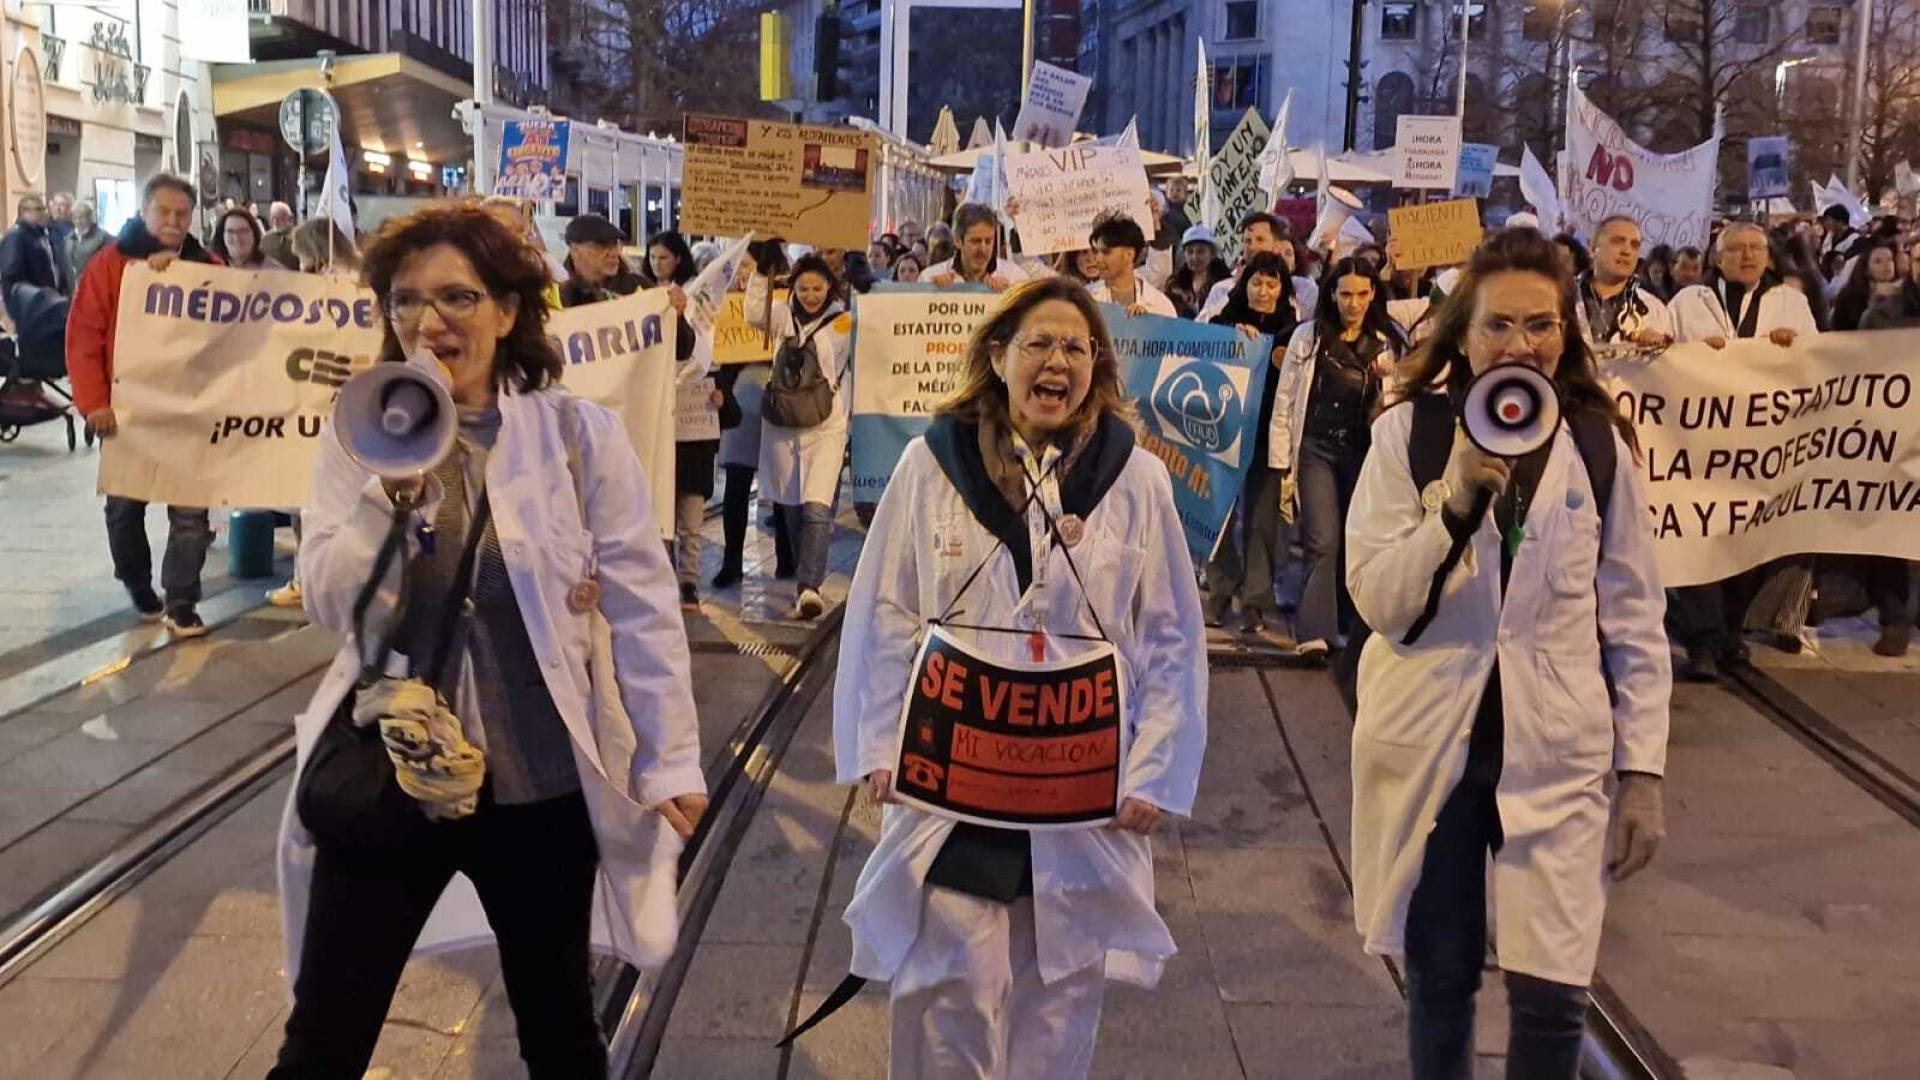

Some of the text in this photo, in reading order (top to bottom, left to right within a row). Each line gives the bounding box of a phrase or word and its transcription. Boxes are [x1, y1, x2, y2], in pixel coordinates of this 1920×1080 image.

[1049, 148, 1097, 172] VIP
[1211, 153, 1231, 188] OY
[1586, 143, 1634, 191] NO
[144, 281, 323, 324] MÉDICOS
[328, 298, 374, 329] DE
[928, 302, 986, 316] POR UN
[893, 322, 962, 337] ESTATUTO
[1176, 338, 1247, 360] COMPUTADA
[892, 362, 912, 376] DE
[913, 361, 931, 375] LA
[918, 379, 955, 394] MÉDI
[1616, 373, 1911, 430] OR UN ESTATUTO
[903, 400, 933, 414] FAC
[210, 415, 285, 444] ¡POR
[1649, 420, 1898, 482] LA PROFESIÓN
[1692, 502, 1717, 537] Y
[920, 650, 1116, 726] SE VENDE
[955, 726, 982, 759] MI
